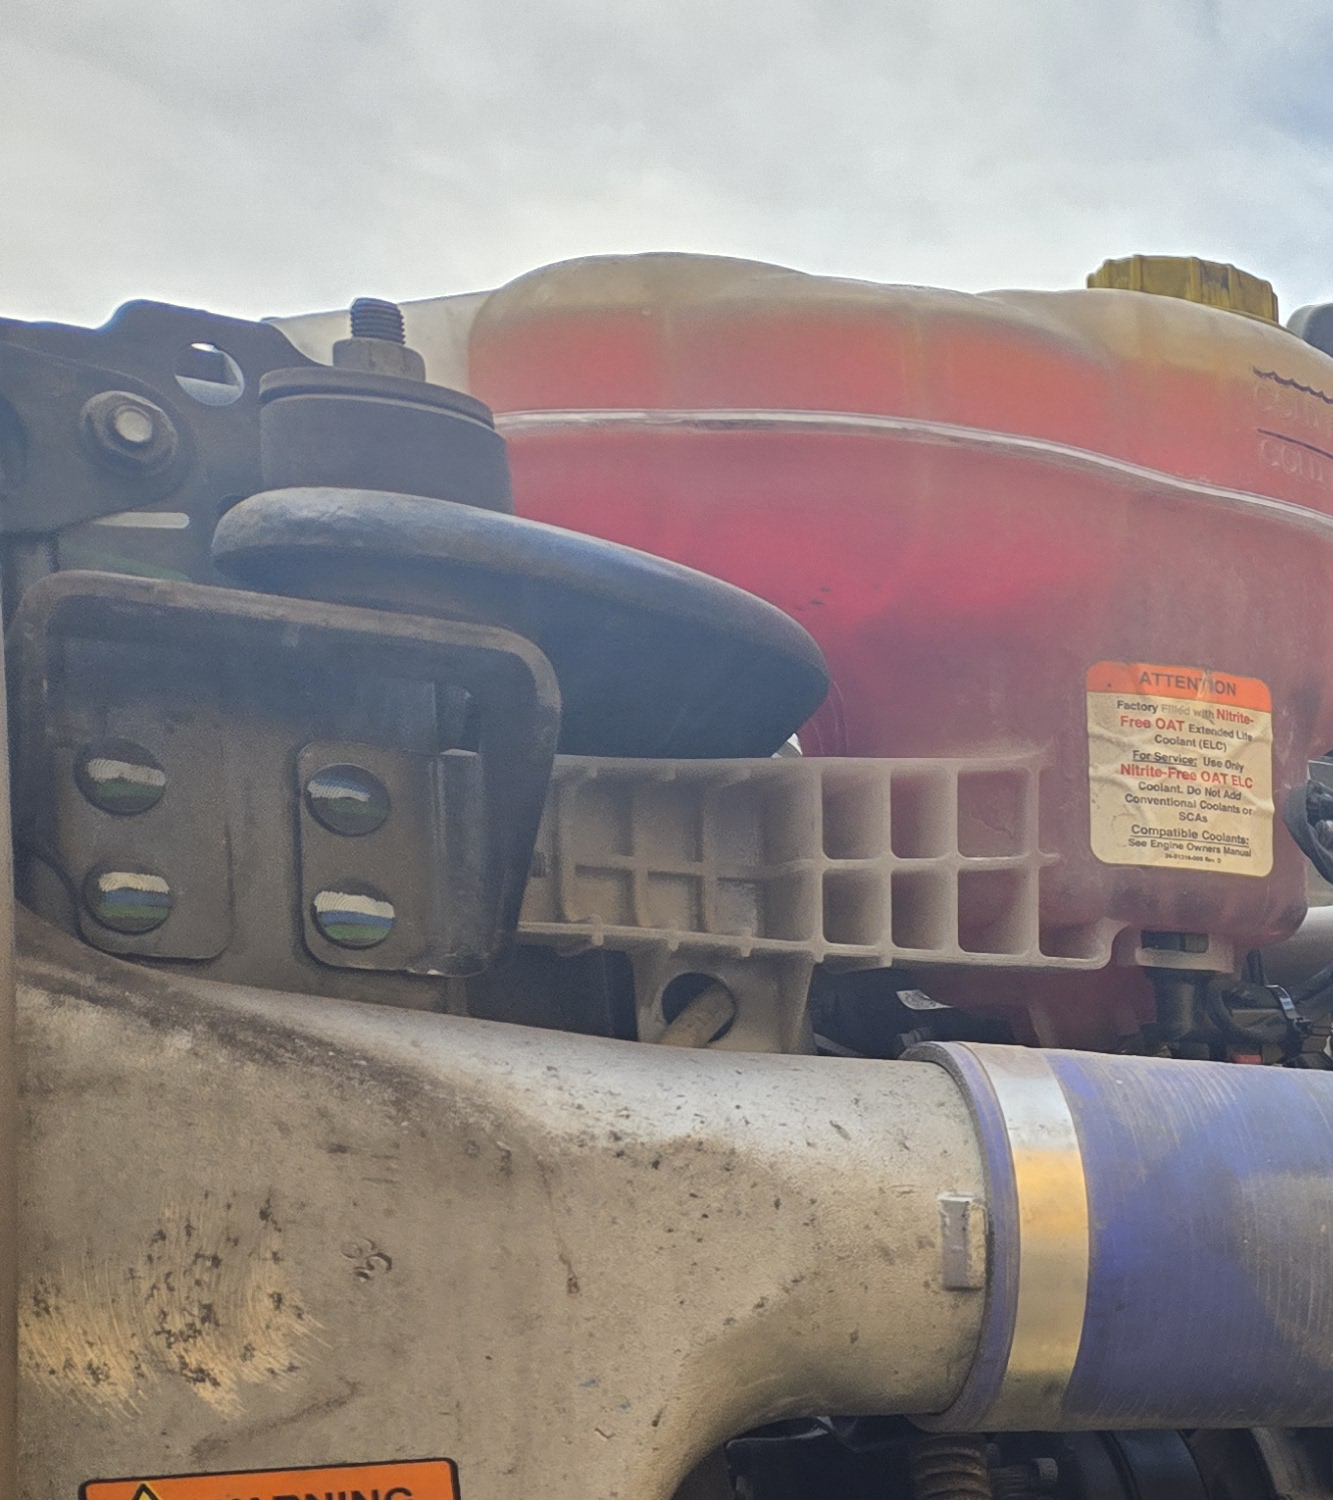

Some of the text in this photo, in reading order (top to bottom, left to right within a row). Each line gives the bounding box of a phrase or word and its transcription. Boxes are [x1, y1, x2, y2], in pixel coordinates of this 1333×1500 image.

[1139, 671, 1236, 696] ATTENTION
[1117, 700, 1254, 725] Factory Filled with Nitrite-
[1120, 715, 1150, 728] Free
[1155, 717, 1185, 731] OAT
[1188, 724, 1234, 738] Extended
[1154, 734, 1227, 752] Coolant (ELC)
[1132, 750, 1244, 773] For Service: Use Only
[1120, 764, 1253, 789] Nitrite-Free OAT ELC
[1138, 781, 1241, 800] Coolant. Do Not Add
[1125, 793, 1252, 815] Conventional Coolants or
[1179, 812, 1208, 823] SCAs
[1131, 824, 1250, 845] Compatible Coolants:
[1128, 838, 1251, 857] See Engine Owners Manual
